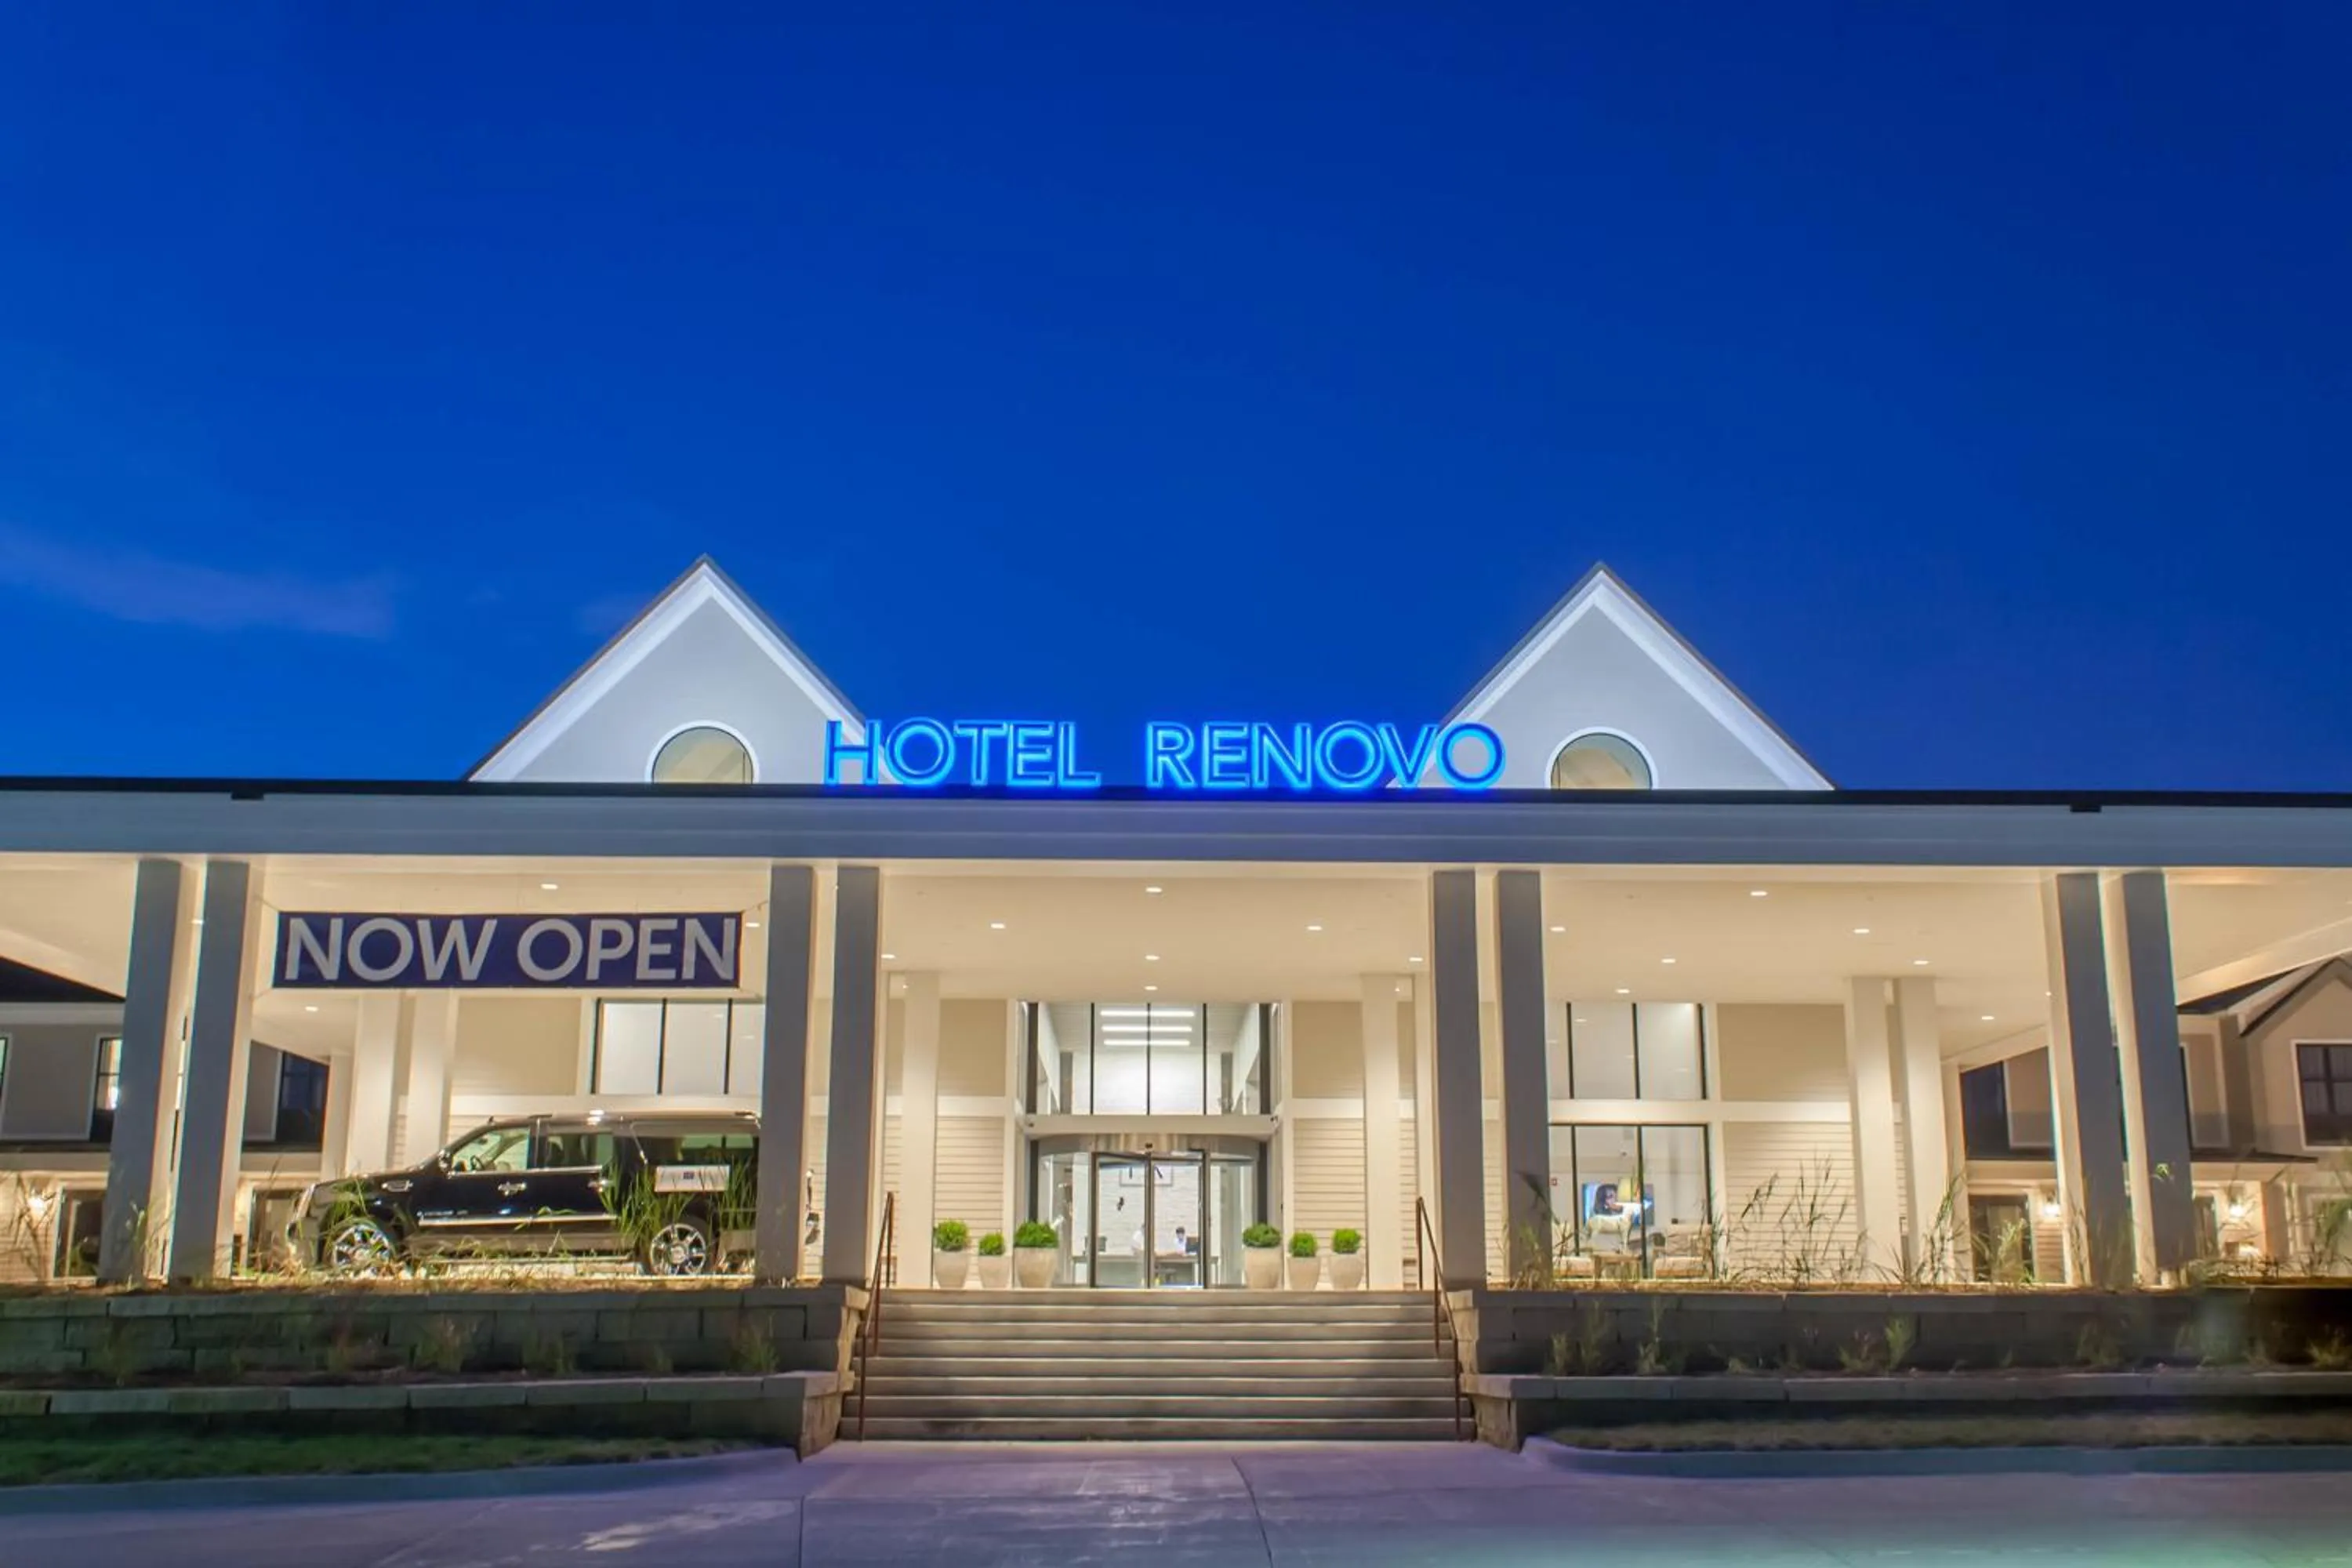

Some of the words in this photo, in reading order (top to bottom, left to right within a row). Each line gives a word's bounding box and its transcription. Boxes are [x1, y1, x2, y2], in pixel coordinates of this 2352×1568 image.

[824, 718, 1099, 788] HOTEL
[1145, 720, 1504, 789] RENOVO
[285, 916, 498, 982] NOW
[517, 917, 736, 982] OPEN
